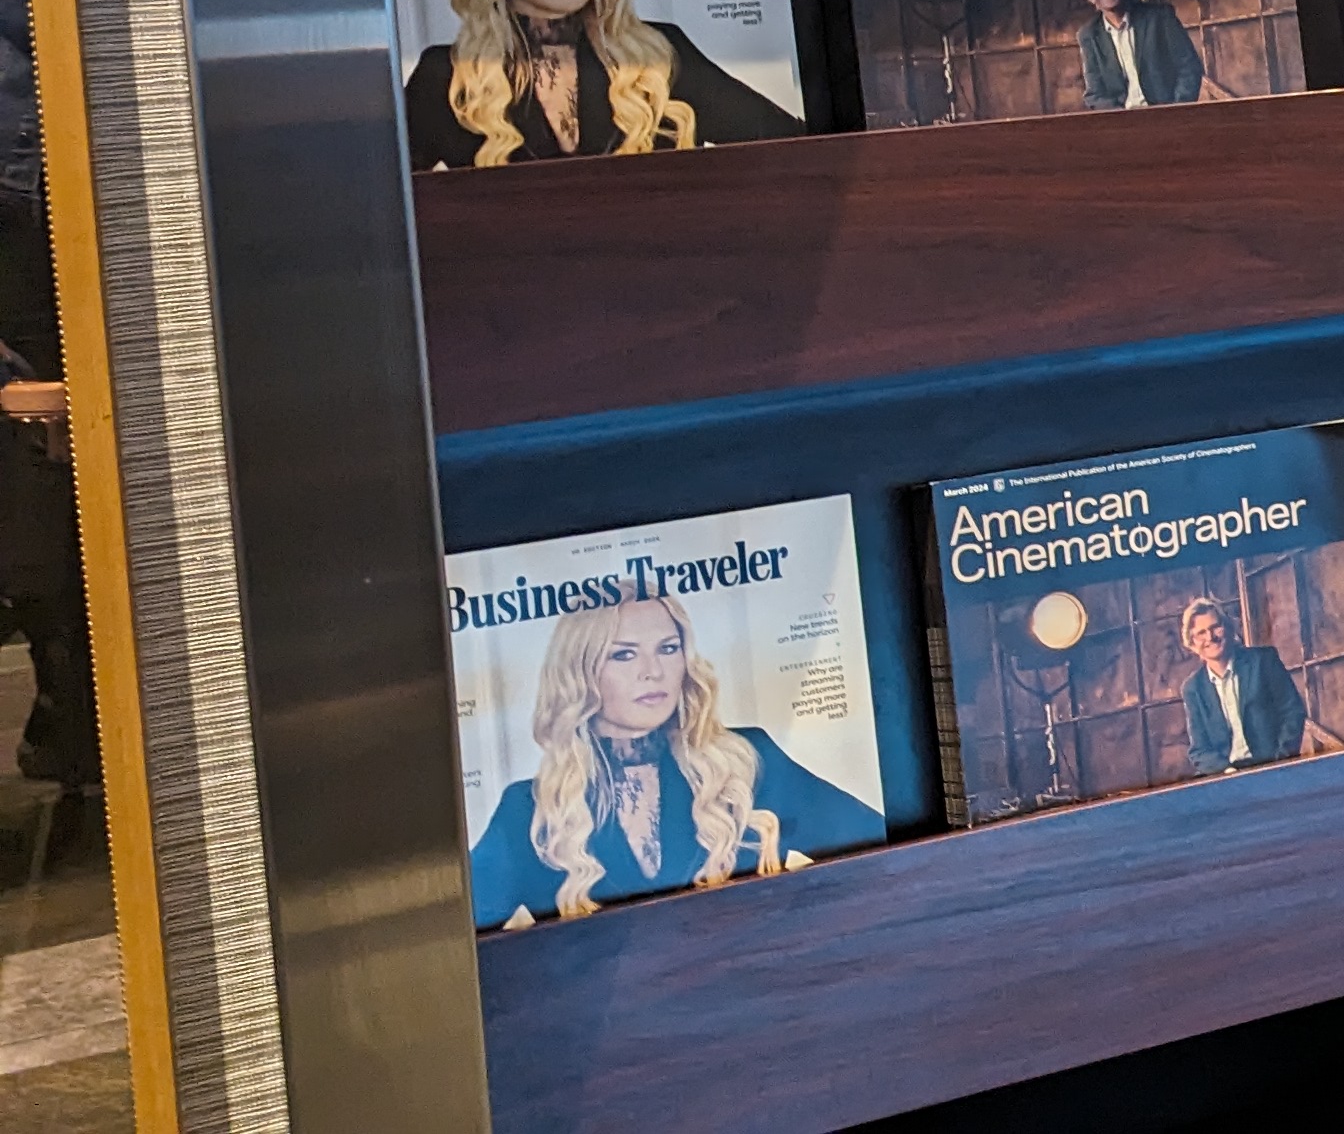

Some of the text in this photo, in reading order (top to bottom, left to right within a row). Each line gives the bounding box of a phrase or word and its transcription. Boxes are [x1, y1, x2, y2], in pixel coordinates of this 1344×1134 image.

[943, 487, 968, 497] March
[969, 483, 989, 494] 2024
[1008, 478, 1023, 487] The
[1129, 457, 1161, 468] American
[1161, 453, 1187, 464] Society
[949, 487, 1150, 547] American
[950, 495, 1307, 584] Cinematographer
[448, 540, 790, 633] Business Traveler
[790, 632, 806, 642] the
[807, 666, 827, 677] Why
[800, 674, 844, 688] streaming
[801, 684, 845, 697] customers
[792, 692, 846, 710] paying more
[796, 701, 848, 717] and getting
